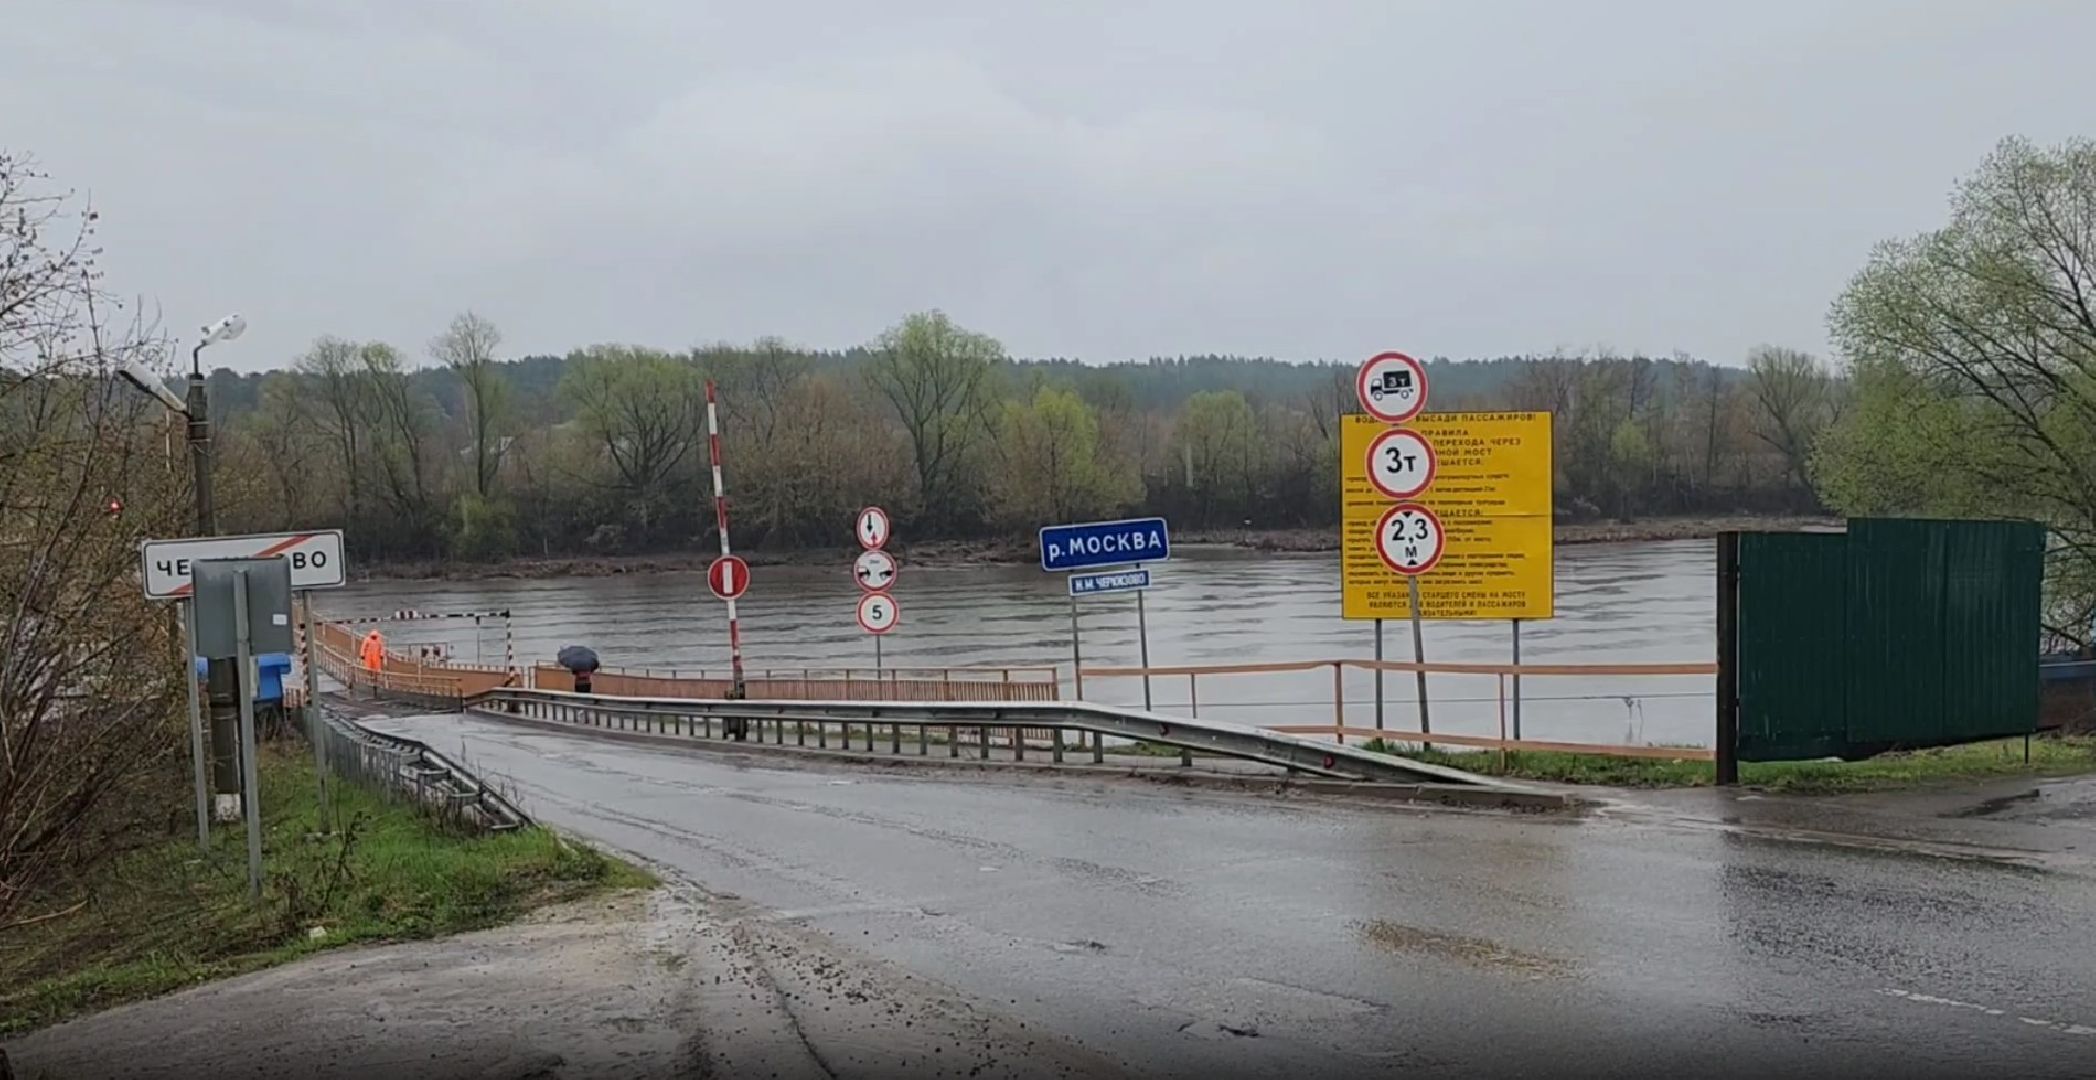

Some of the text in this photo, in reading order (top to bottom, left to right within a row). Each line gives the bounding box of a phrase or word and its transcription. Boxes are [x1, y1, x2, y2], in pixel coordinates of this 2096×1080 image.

[1416, 414, 1457, 422] ВЫСАДИ
[1433, 436, 1521, 446] ПЕРЕХОДА ЧЕРЕЗ
[1463, 447, 1493, 456] МОСТ
[1391, 518, 1429, 544] 2,3
[872, 604, 883, 620] 5
